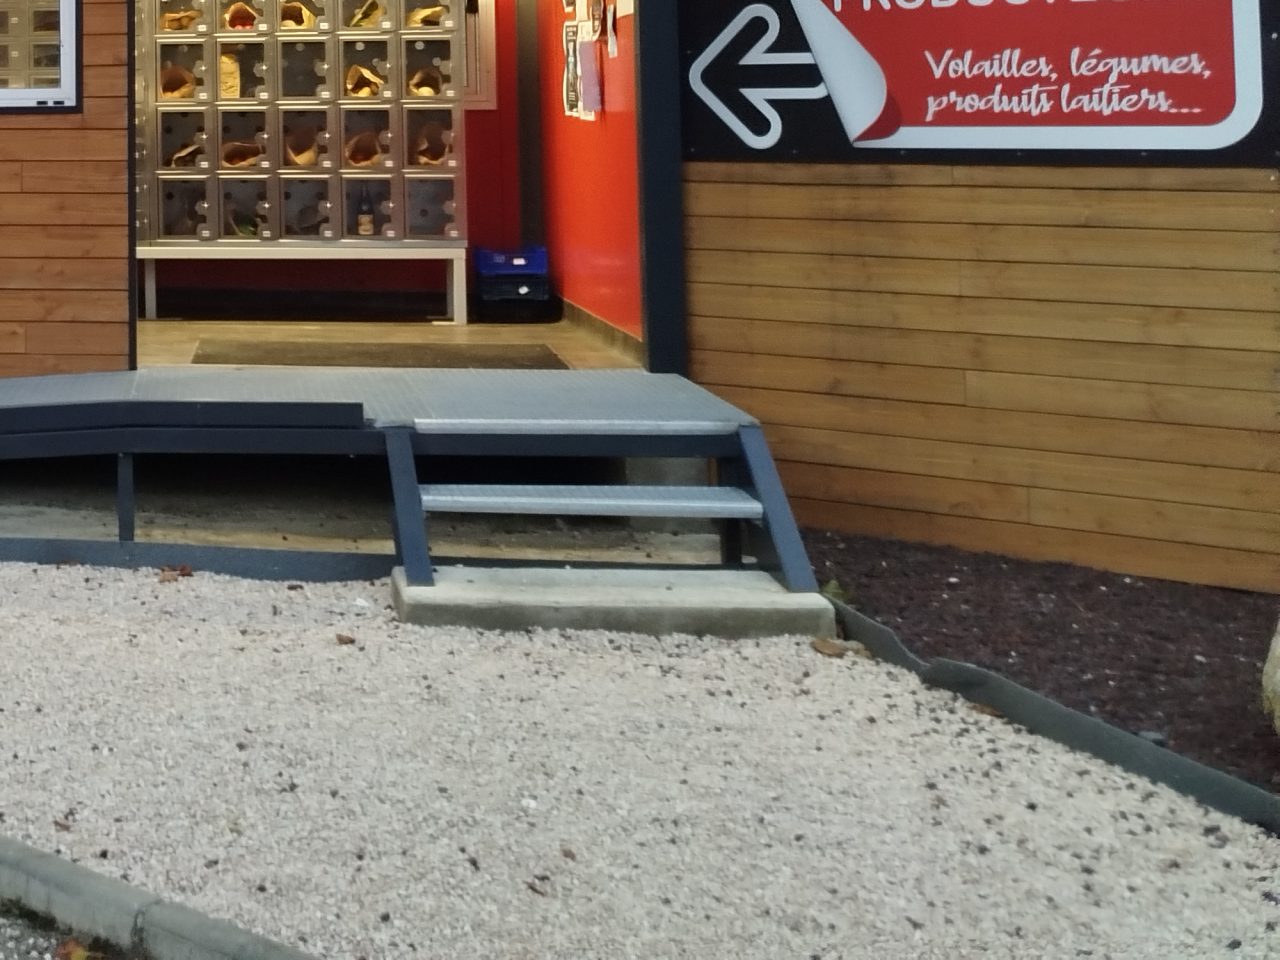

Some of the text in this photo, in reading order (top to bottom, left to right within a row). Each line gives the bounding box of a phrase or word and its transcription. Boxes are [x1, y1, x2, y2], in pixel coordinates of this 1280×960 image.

[924, 47, 1211, 84] Volailles, légumes,
[925, 83, 1058, 122] produits
